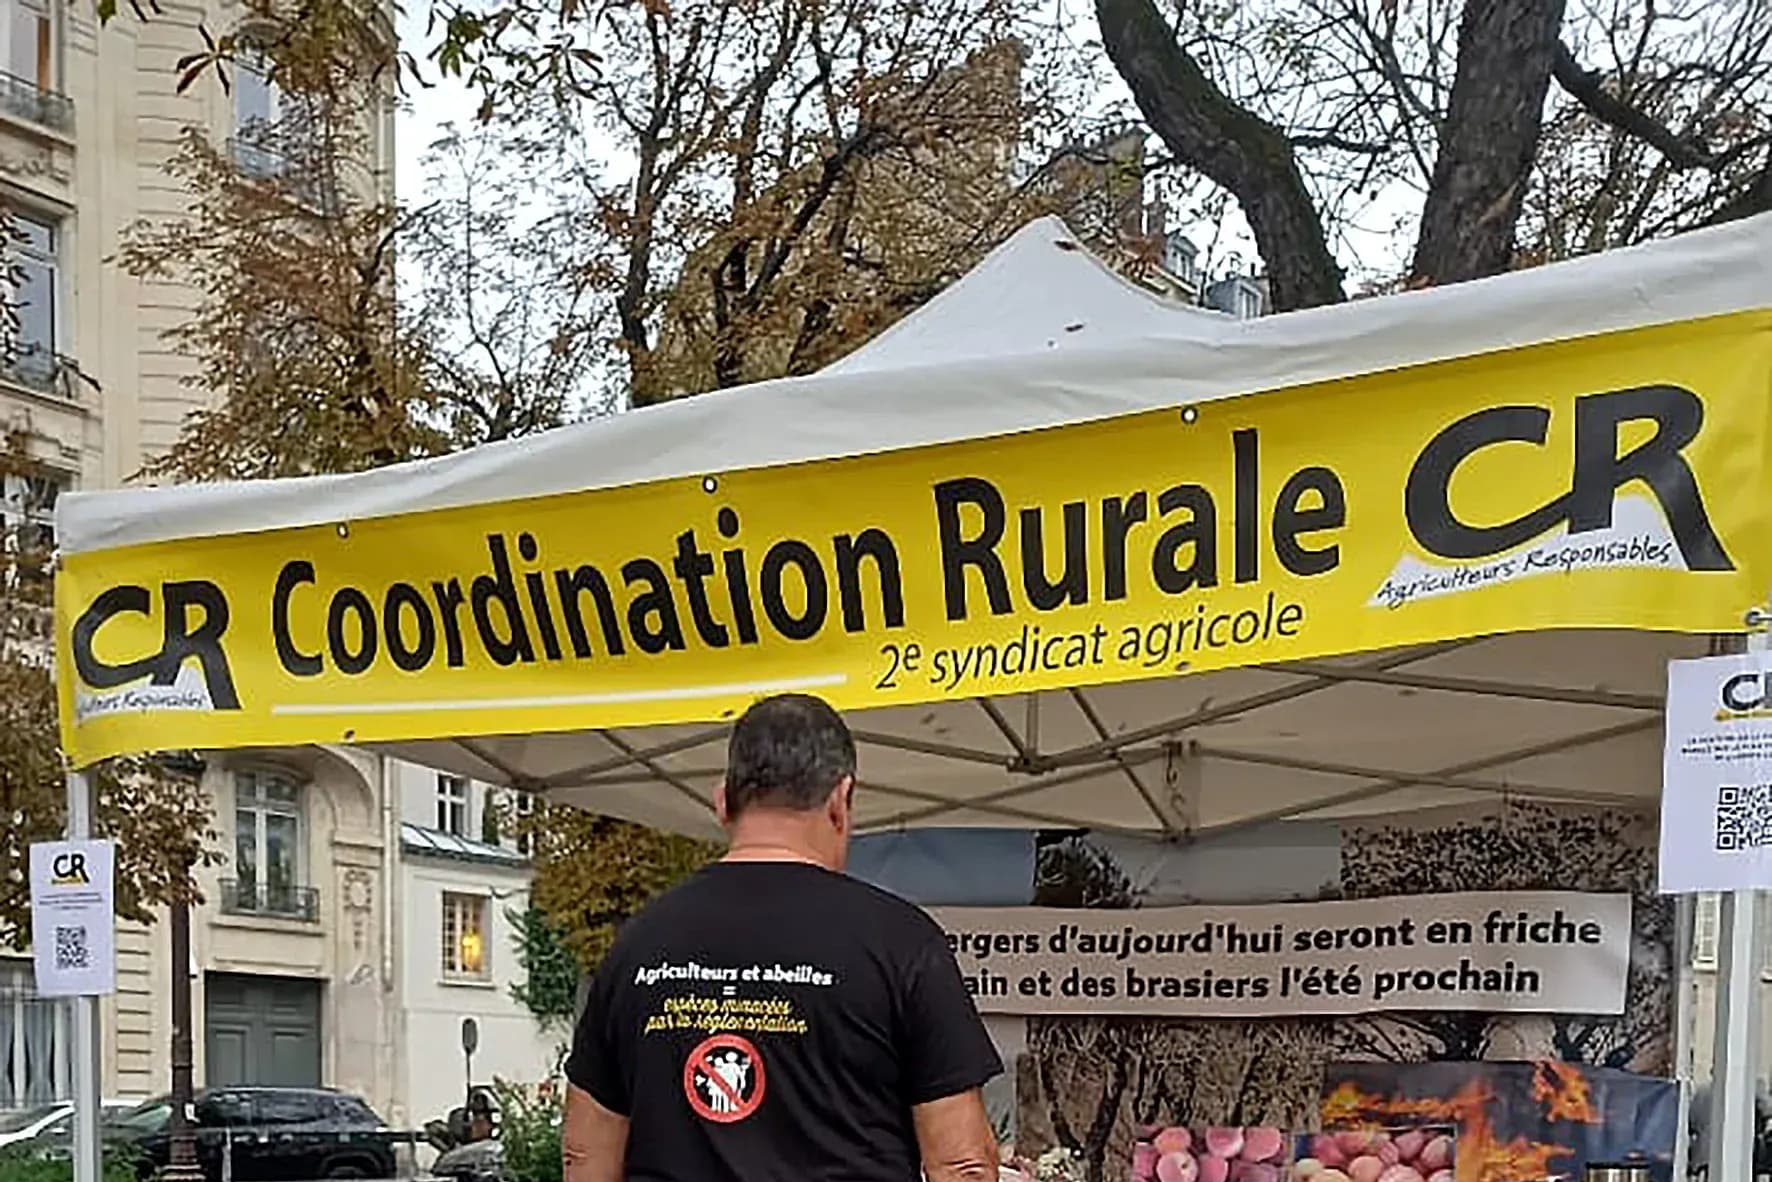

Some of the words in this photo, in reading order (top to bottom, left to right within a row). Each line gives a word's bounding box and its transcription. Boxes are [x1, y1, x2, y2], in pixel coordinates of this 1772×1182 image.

[1404, 384, 1738, 572] CR
[272, 506, 905, 677] Coordination
[932, 427, 1347, 621] Rurale
[1377, 559, 1516, 611] Agriculteurs
[1523, 535, 1673, 575] Responsables
[71, 579, 243, 711] CR
[929, 623, 1108, 691] syndicat
[1117, 591, 1303, 668] agricole
[1722, 671, 1772, 711] C
[53, 853, 91, 884] CR
[944, 932, 1040, 960] ergers
[1048, 922, 1283, 961] d'aujourd'hui
[1293, 918, 1416, 951] seront
[1425, 921, 1473, 944] en
[1483, 909, 1601, 944] friche
[633, 961, 738, 985] Agriculteurs
[741, 964, 762, 982] et
[762, 963, 833, 986] abeilles
[962, 967, 1008, 996] ain
[1017, 970, 1052, 997] et
[1060, 966, 1117, 997] des
[1126, 967, 1269, 998] brasiers
[1280, 964, 1361, 997] l'été
[1372, 958, 1540, 1000] prochain
